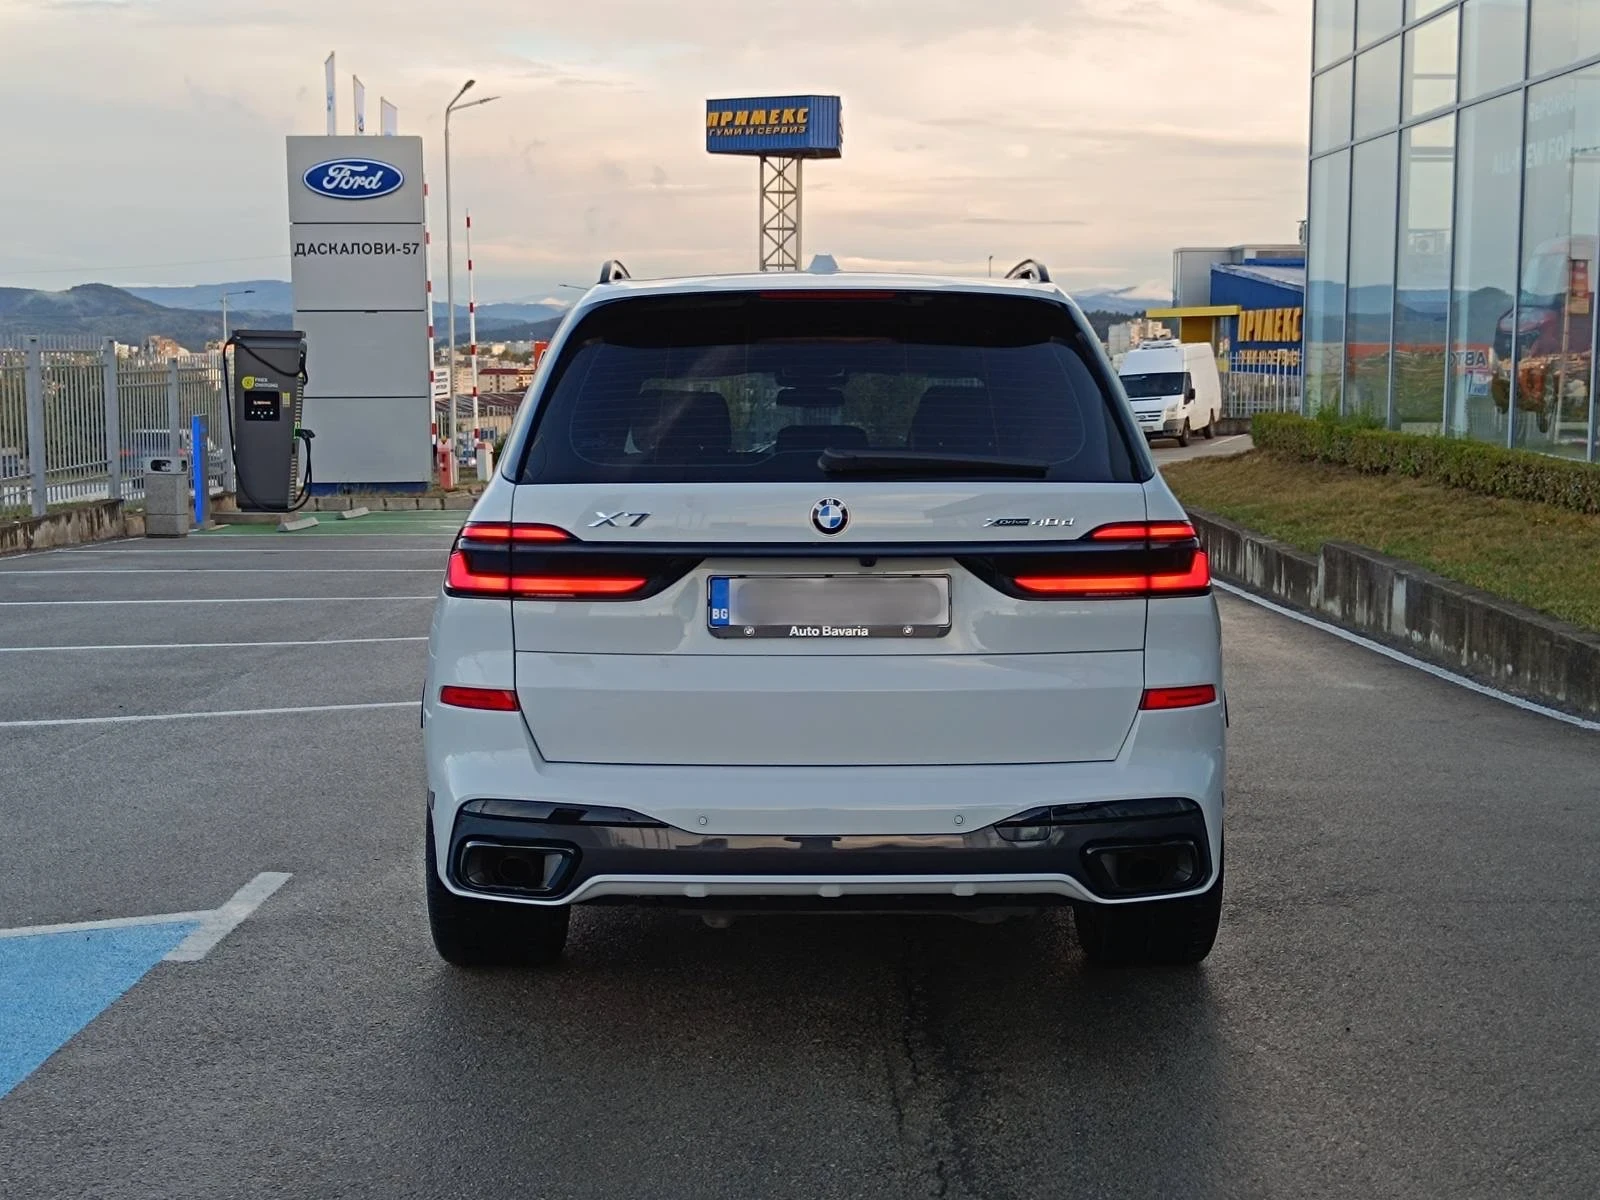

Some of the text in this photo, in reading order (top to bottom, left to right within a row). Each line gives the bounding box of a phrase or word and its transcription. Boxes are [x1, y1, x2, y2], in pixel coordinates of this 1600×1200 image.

[707, 108, 809, 128] ПРИМЕКС
[708, 125, 806, 137] ГУМИ И СЕРВИЗ
[322, 164, 384, 190] Ford
[294, 242, 420, 257] ДАСКАЛОВИ-57
[1237, 307, 1302, 342] ПРИМЕКС
[588, 511, 652, 528] X7
[712, 608, 728, 620] BG
[789, 625, 869, 637] Auto Bavaria
